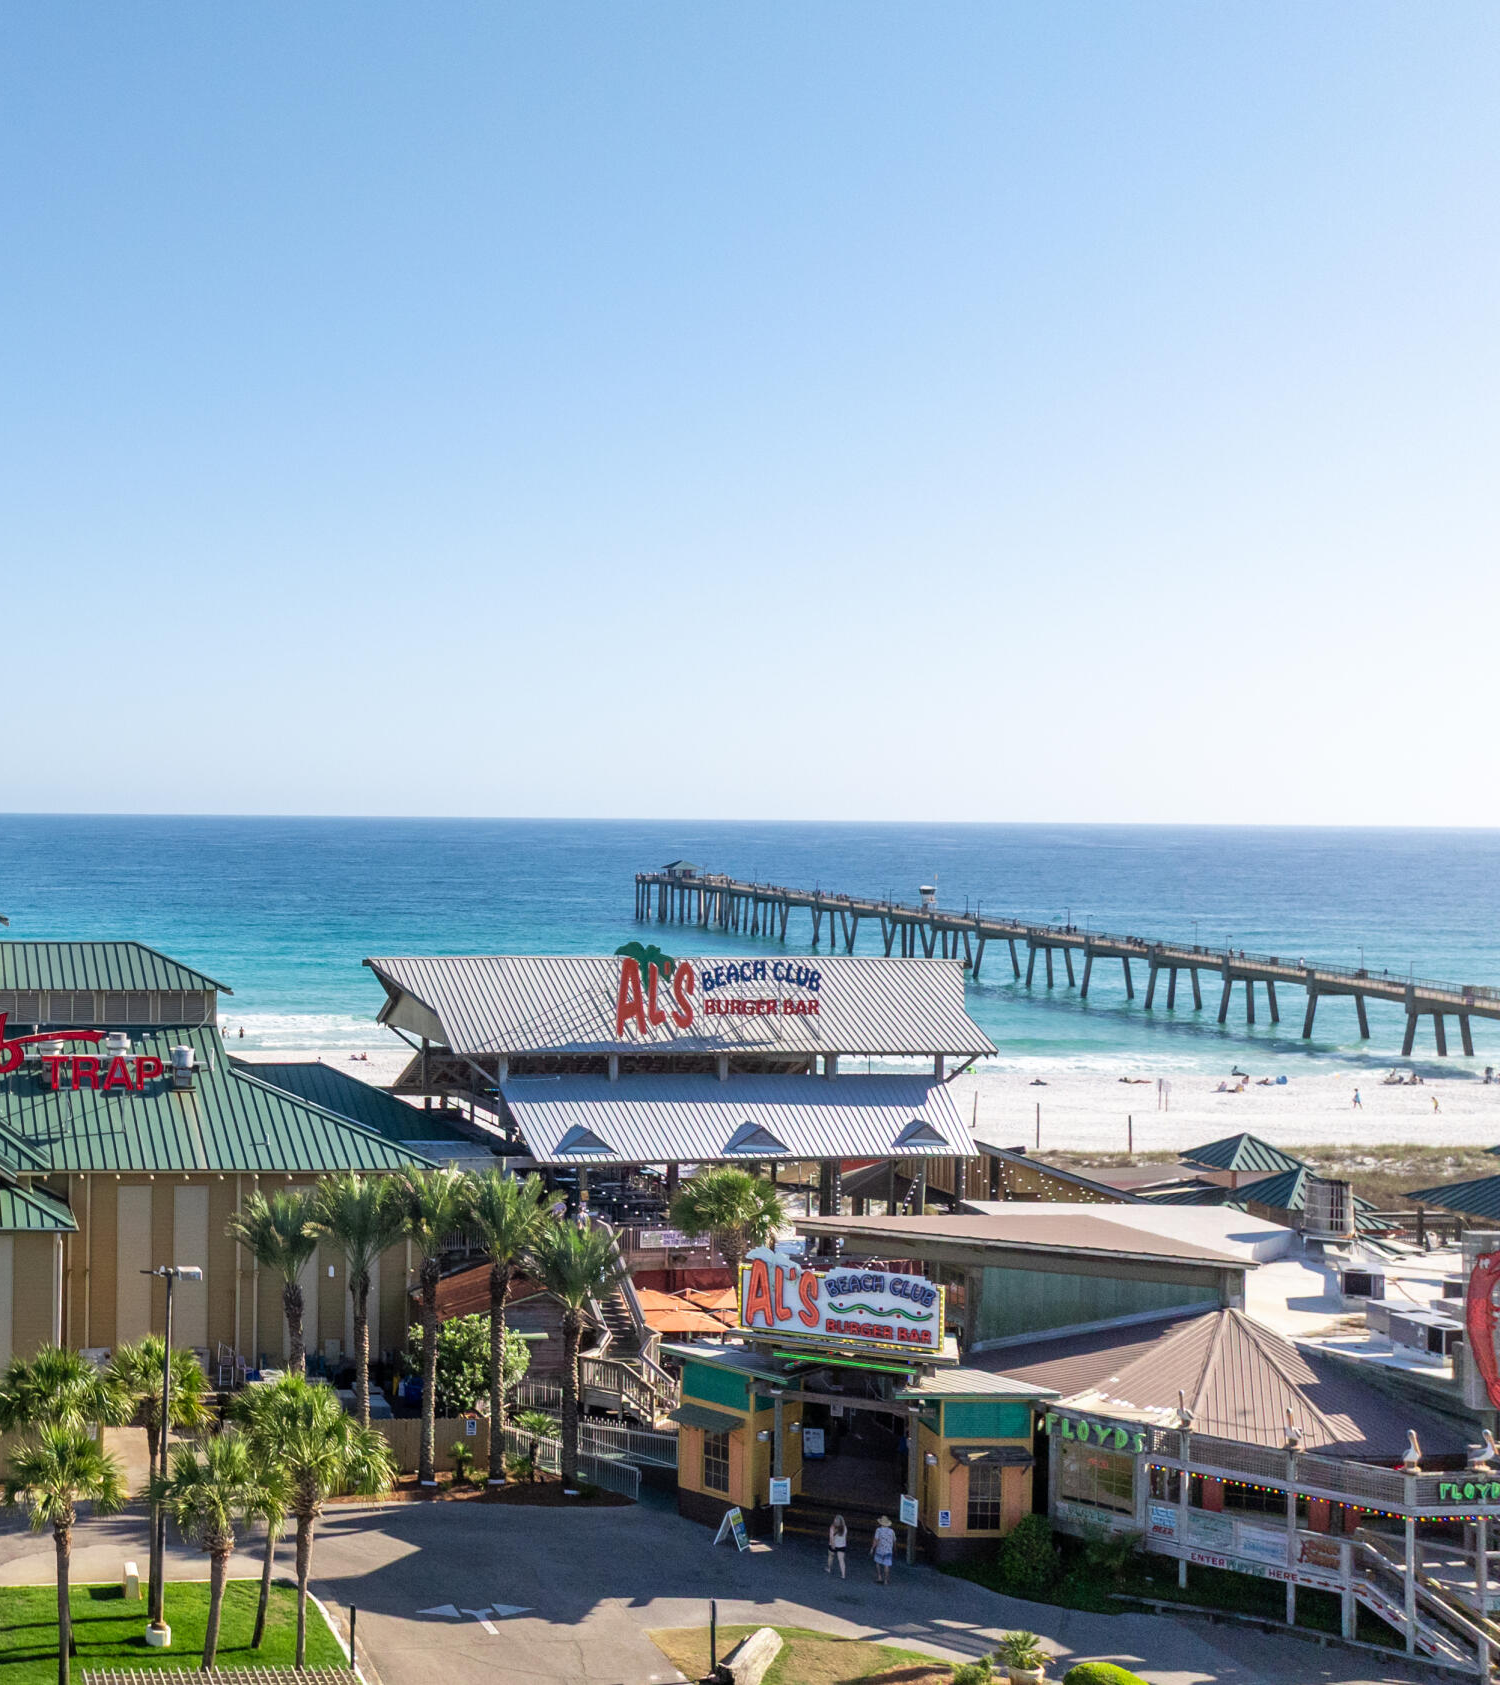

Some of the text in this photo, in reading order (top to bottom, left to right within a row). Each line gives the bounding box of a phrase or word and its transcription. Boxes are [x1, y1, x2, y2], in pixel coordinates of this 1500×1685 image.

[701, 961, 822, 992] BEACH CLUB
[616, 957, 695, 1037] AL'S
[703, 999, 820, 1016] BURGER BAR
[41, 1055, 164, 1091] TRAP
[745, 1259, 820, 1328] AL'S
[824, 1273, 937, 1308] BEACH CLUB
[825, 1318, 932, 1345] BURGER BAR
[1045, 1412, 1147, 1453] FLOYDS
[1152, 1525, 1174, 1536] BEER
[1191, 1552, 1226, 1568] ENTER
[1268, 1568, 1299, 1583] HERE
